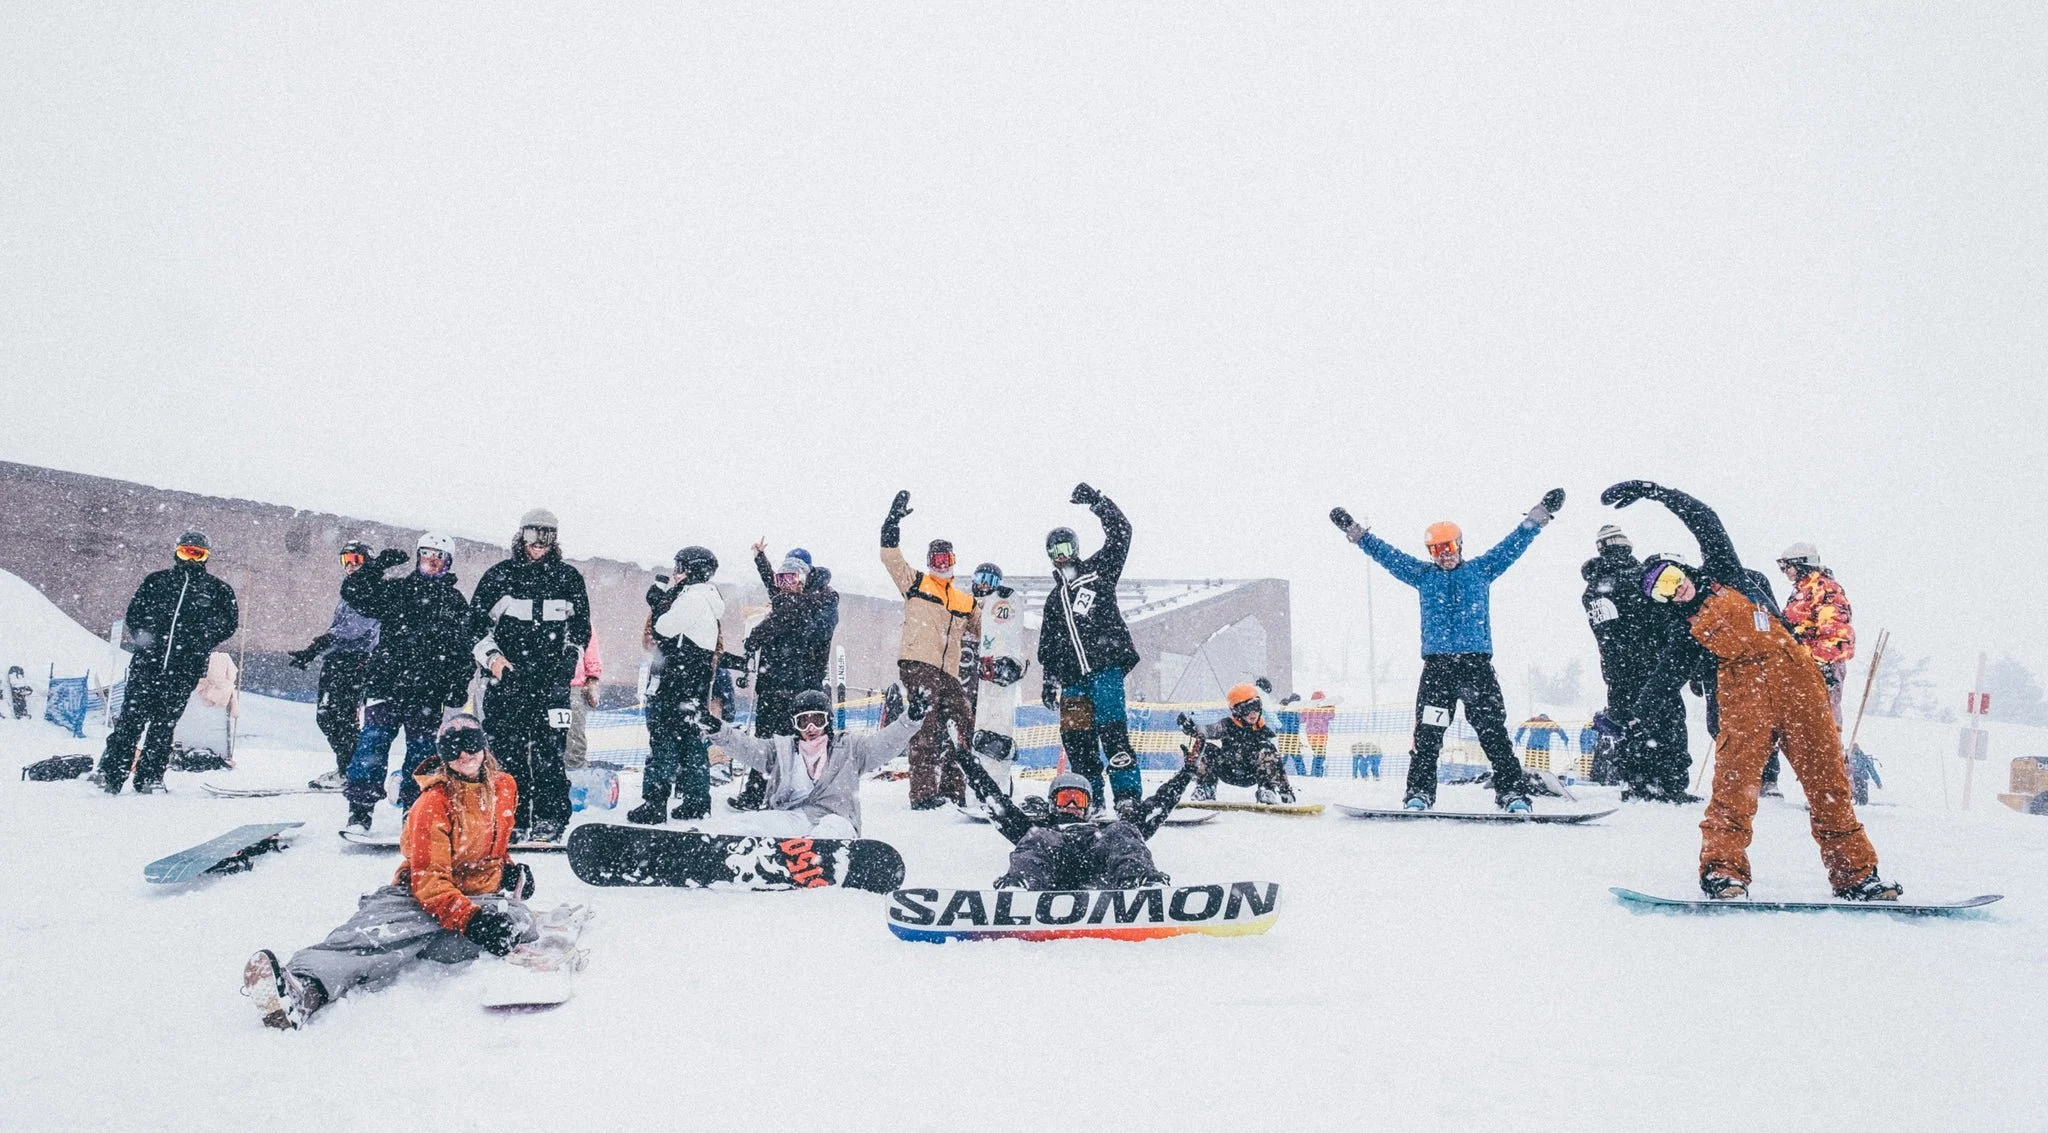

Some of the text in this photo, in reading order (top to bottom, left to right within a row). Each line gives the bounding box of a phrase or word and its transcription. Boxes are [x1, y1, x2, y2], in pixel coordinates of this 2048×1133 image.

[1077, 593, 1092, 609] 23
[996, 606, 1009, 620] 20
[1434, 709, 1444, 723] 7
[889, 881, 1280, 926] SALOMON
